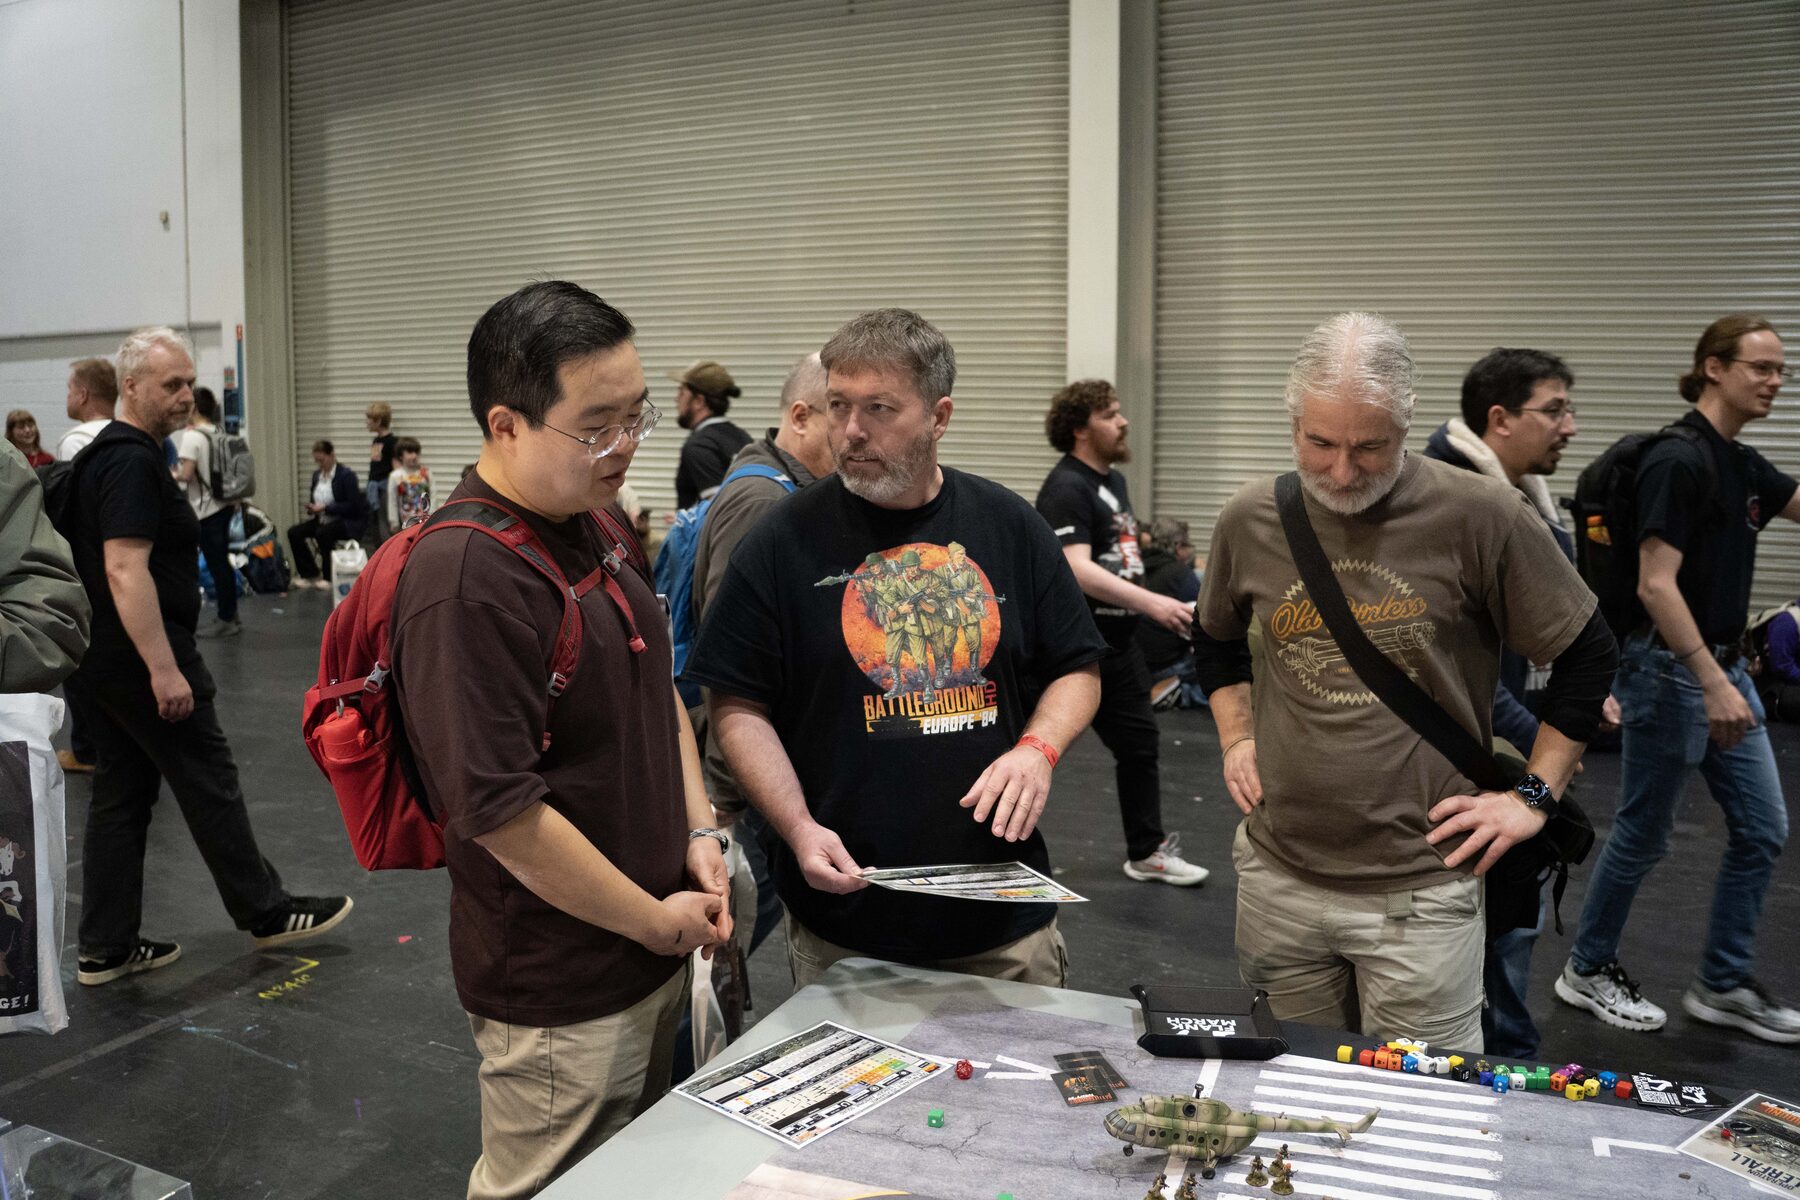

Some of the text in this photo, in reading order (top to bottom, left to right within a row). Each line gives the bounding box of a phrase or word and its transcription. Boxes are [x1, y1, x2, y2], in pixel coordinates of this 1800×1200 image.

[1272, 599, 1322, 639] Old
[923, 713, 975, 735] EUROPE
[1166, 1016, 1237, 1027] MARCH
[1169, 1022, 1235, 1032] FLANK
[1747, 1168, 1795, 1191] OPERATION
